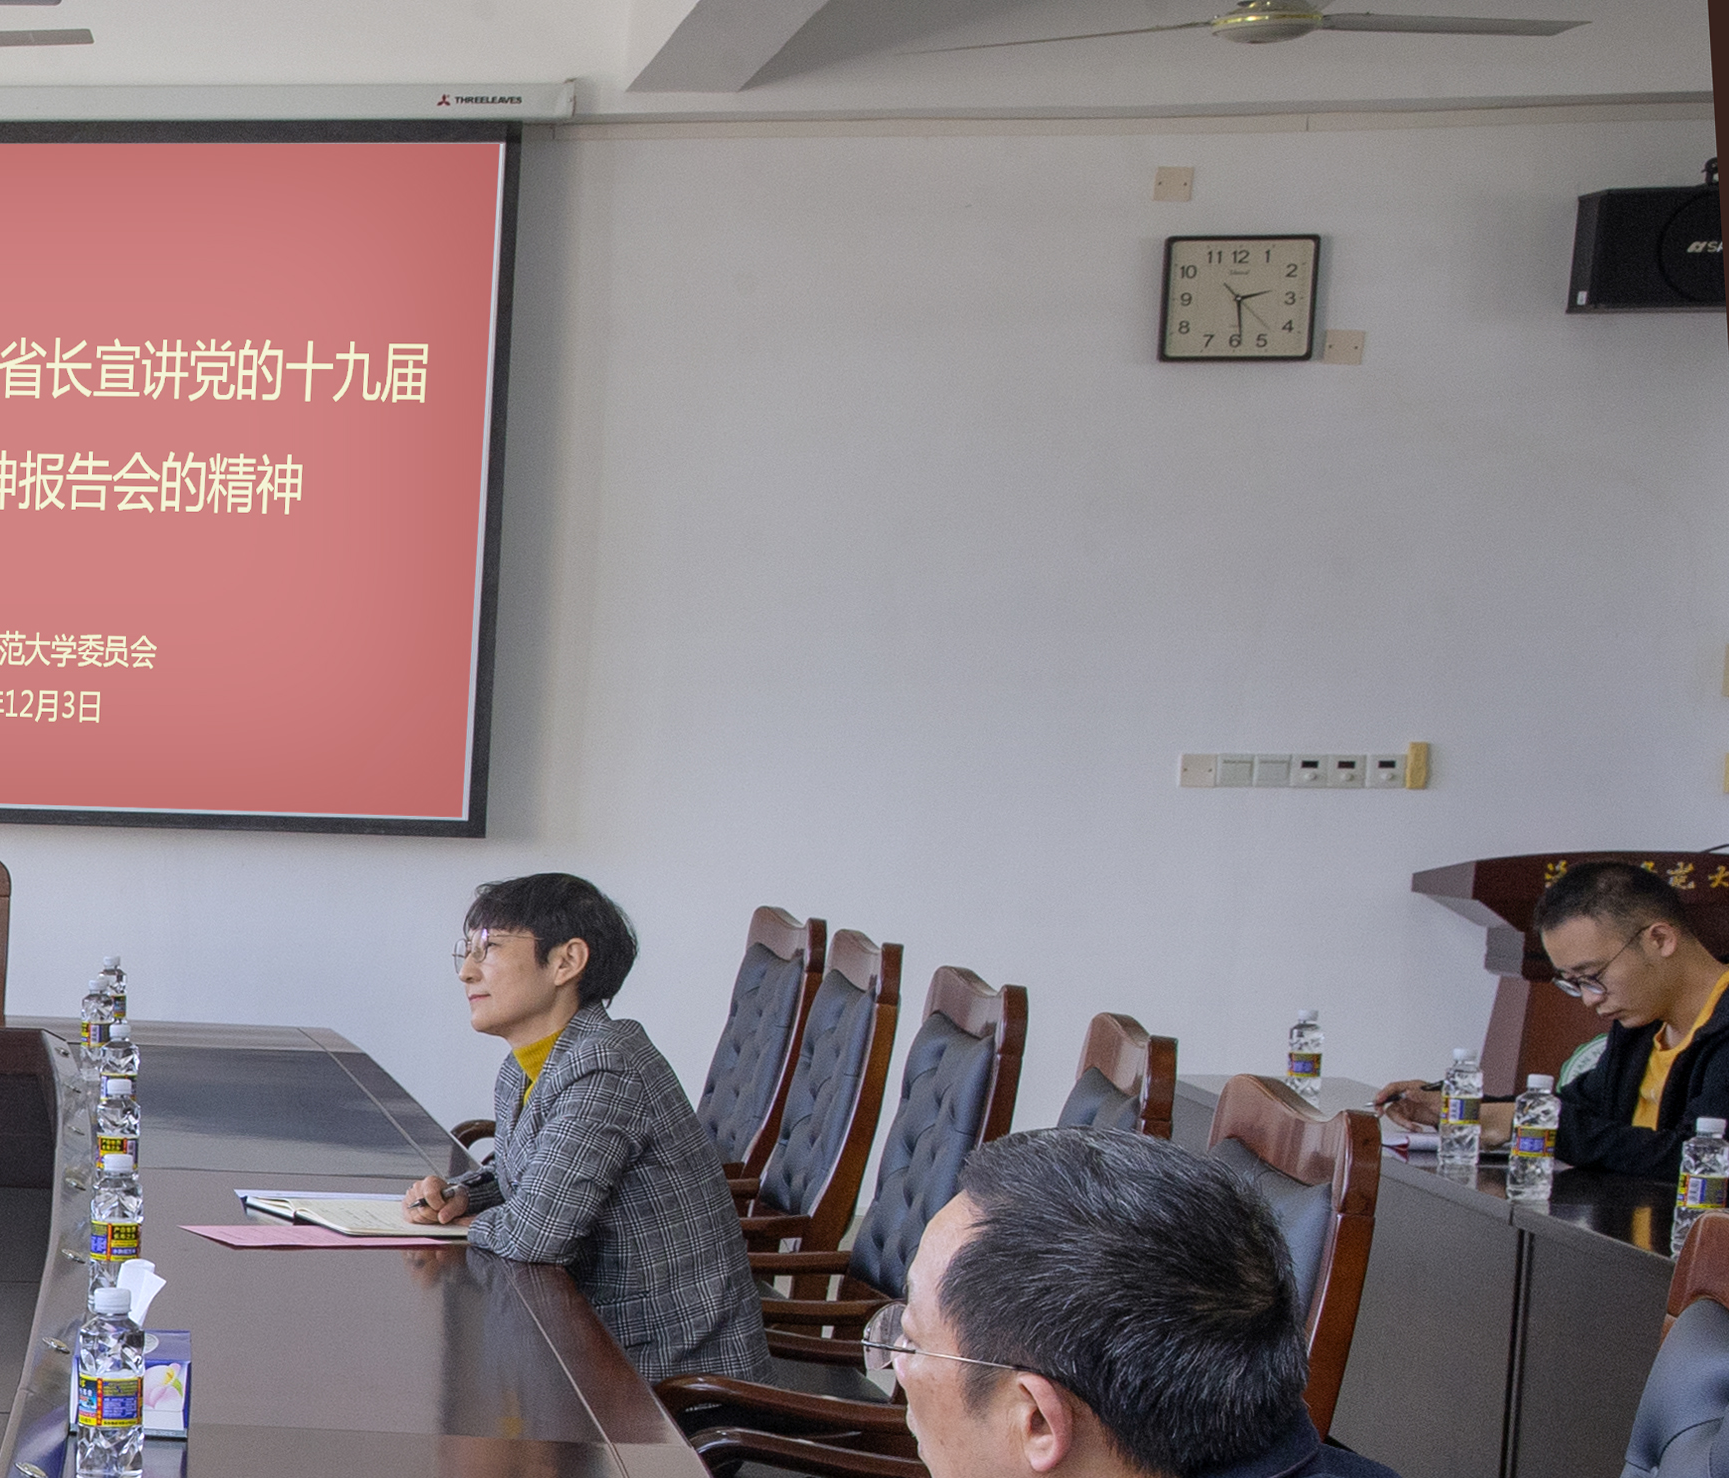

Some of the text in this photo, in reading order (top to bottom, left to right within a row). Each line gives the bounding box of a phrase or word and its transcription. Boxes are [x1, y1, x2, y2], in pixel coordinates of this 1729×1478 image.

[454, 96, 523, 105] THREELEAVES
[1207, 250, 1223, 264] 11
[1232, 249, 1250, 264] 12
[1265, 249, 1271, 263] 1
[1180, 264, 1197, 279] 10
[1285, 263, 1298, 278] 2
[1180, 292, 1192, 306] 9
[1284, 291, 1297, 305] 3
[1178, 320, 1191, 335] 8
[1281, 319, 1294, 333] 4
[1203, 333, 1215, 348] 7
[1228, 333, 1242, 348] 6
[1256, 333, 1268, 348] 5
